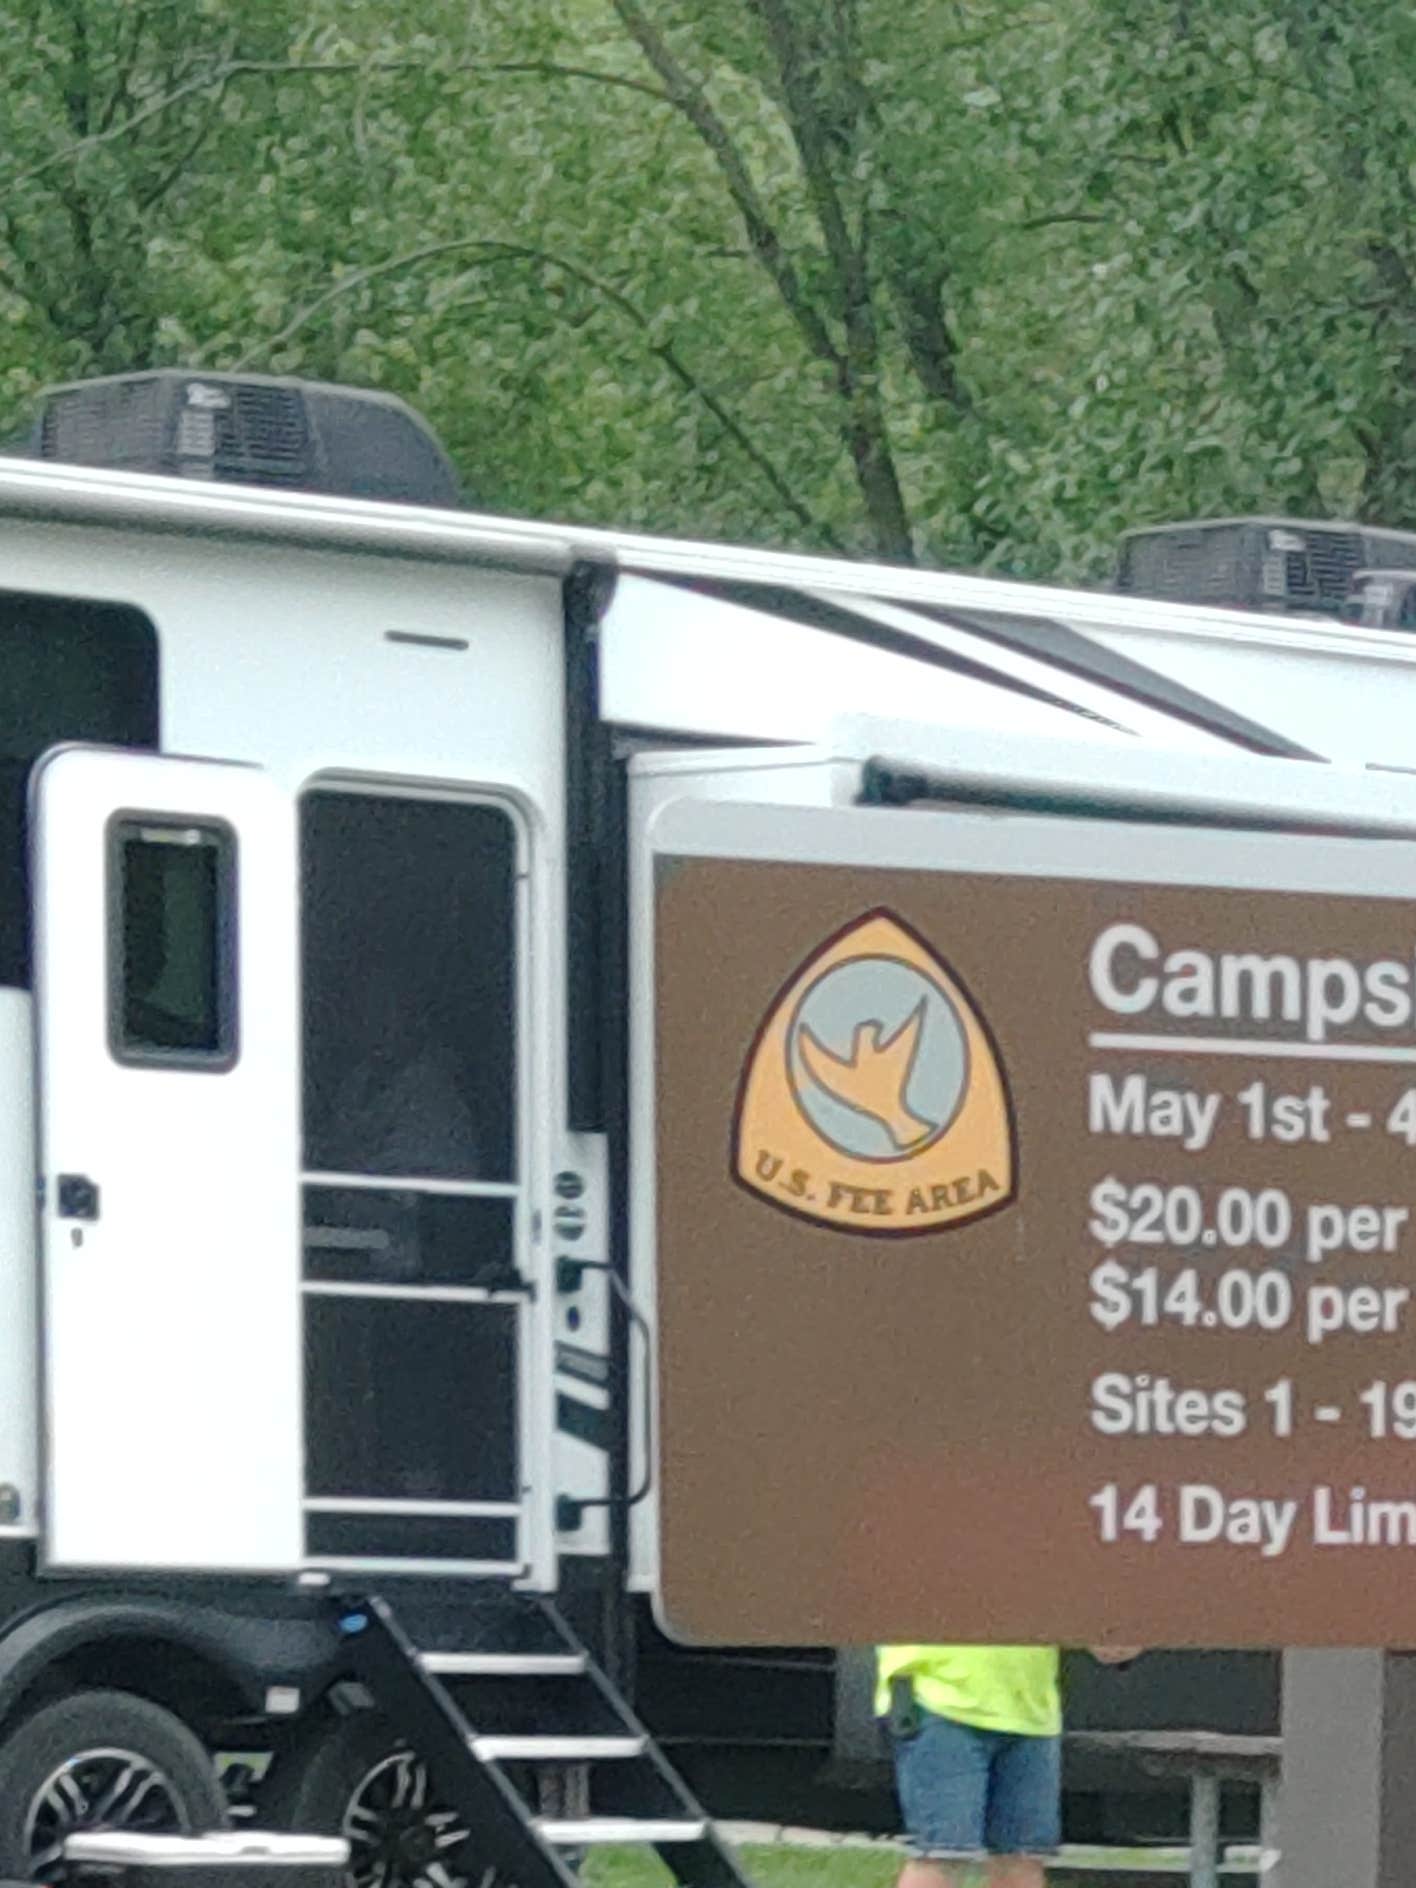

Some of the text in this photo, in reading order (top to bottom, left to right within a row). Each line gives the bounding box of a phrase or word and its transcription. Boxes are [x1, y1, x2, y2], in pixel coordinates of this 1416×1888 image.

[1089, 1072, 1220, 1151] May
[1238, 1082, 1331, 1143] 1st
[1346, 1113, 1372, 1128] -
[826, 1181, 893, 1214] FEE
[905, 1168, 1000, 1214] AREA
[1089, 1177, 1292, 1249] $20.00
[1308, 1205, 1409, 1261] per
[1089, 1259, 1292, 1331] $14.00
[1308, 1287, 1409, 1344] per
[1091, 1373, 1246, 1437] Sites
[1264, 1379, 1292, 1437] 1
[1315, 1407, 1341, 1422] -
[1089, 1484, 1163, 1543] 14
[1180, 1485, 1297, 1557] Day
